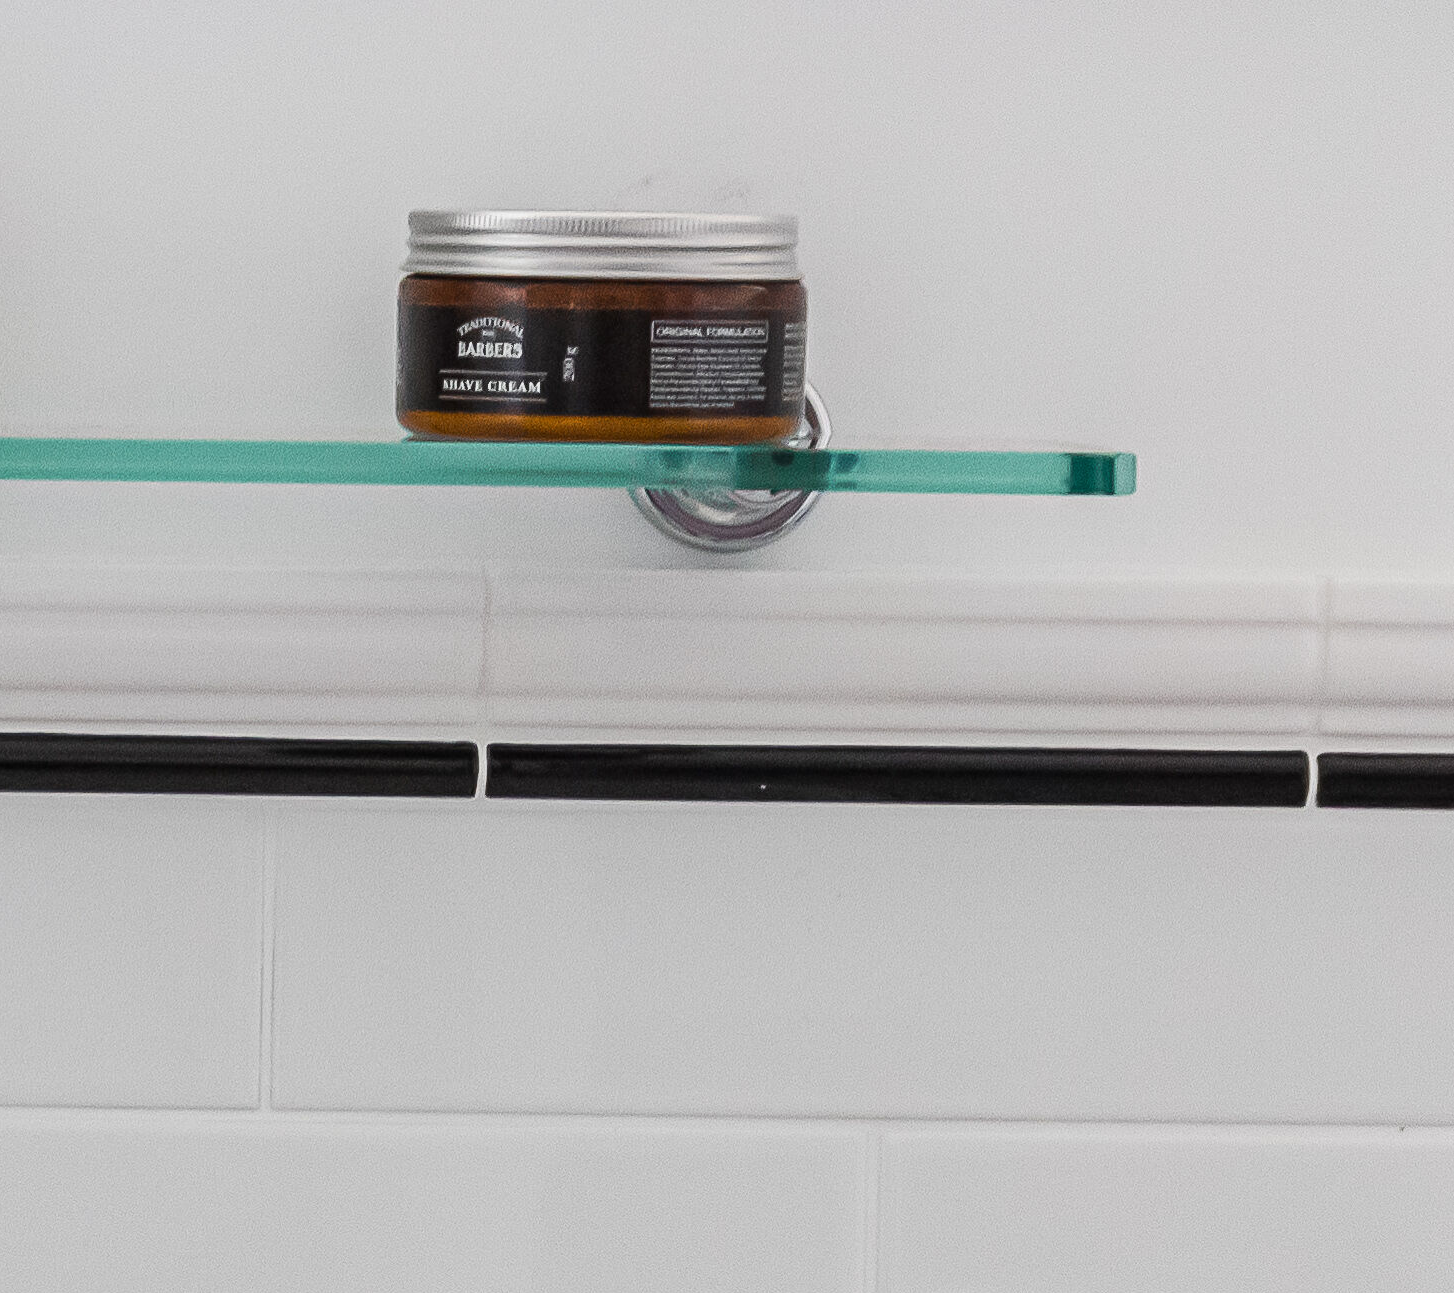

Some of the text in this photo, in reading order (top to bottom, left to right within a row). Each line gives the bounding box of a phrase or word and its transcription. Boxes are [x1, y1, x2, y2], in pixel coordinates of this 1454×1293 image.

[456, 317, 525, 338] TRADITIONAL
[457, 341, 523, 359] BARBERS
[442, 378, 541, 394] SHAVE CREAM
